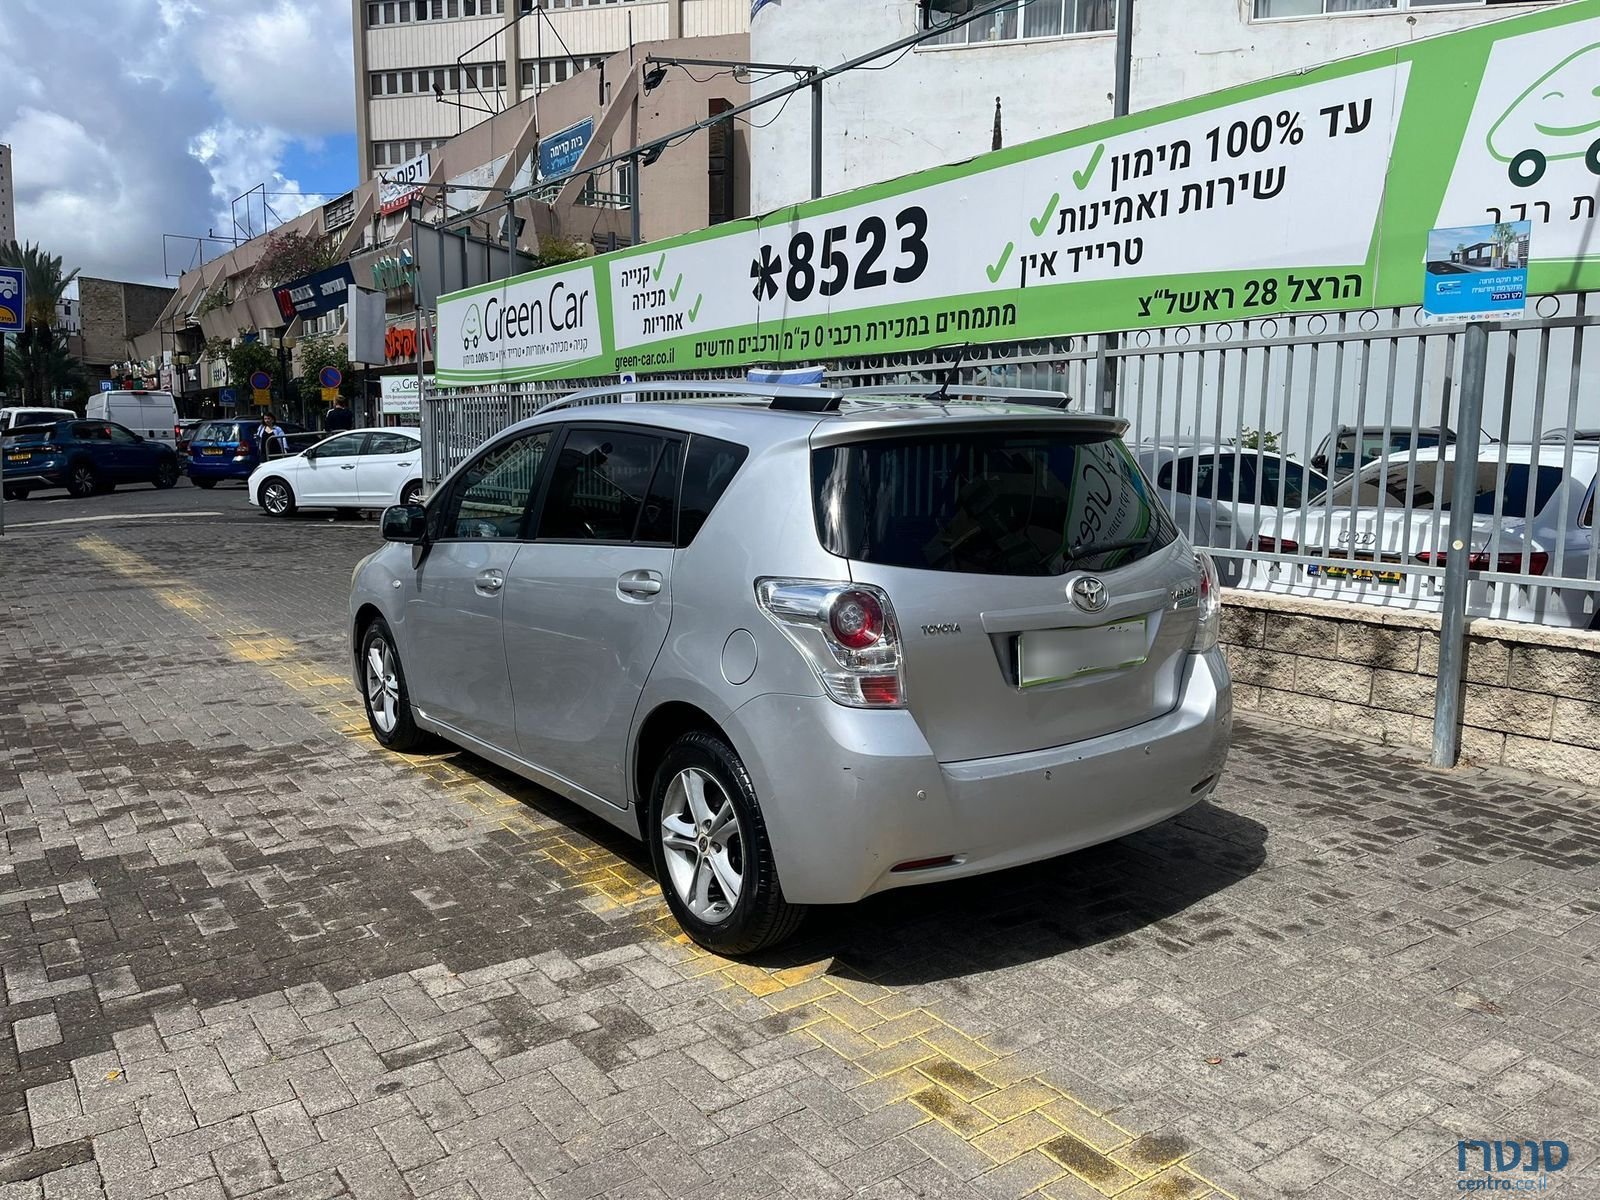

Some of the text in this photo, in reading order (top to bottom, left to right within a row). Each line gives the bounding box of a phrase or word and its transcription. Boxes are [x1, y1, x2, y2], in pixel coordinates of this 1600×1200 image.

[550, 141, 569, 158] קדימה
[571, 136, 583, 150] בית
[1111, 98, 1373, 192] עד 100% מימון
[1057, 165, 1287, 236] שירות ואמינות
[1020, 237, 1144, 288] טרייד אין
[621, 266, 650, 288] קנייה
[1243, 278, 1278, 307] 28
[1287, 274, 1362, 303] הרצל
[632, 289, 666, 310] מכירה
[485, 281, 589, 342] Green Car
[936, 303, 1017, 333] מתמחים
[643, 312, 684, 335] אחריות
[865, 315, 930, 342] במכירת
[738, 335, 779, 355] ורכבים
[814, 325, 824, 344] 0
[828, 325, 861, 346] רכבי
[508, 347, 522, 359] טרייד
[525, 344, 546, 357] אחריות
[550, 341, 569, 354] מכירה
[573, 338, 588, 353] קניה
[695, 338, 735, 358] חדשים
[475, 353, 489, 364] 100%
[615, 348, 675, 371] green-car.co.il
[920, 623, 962, 636] TOYOTA
